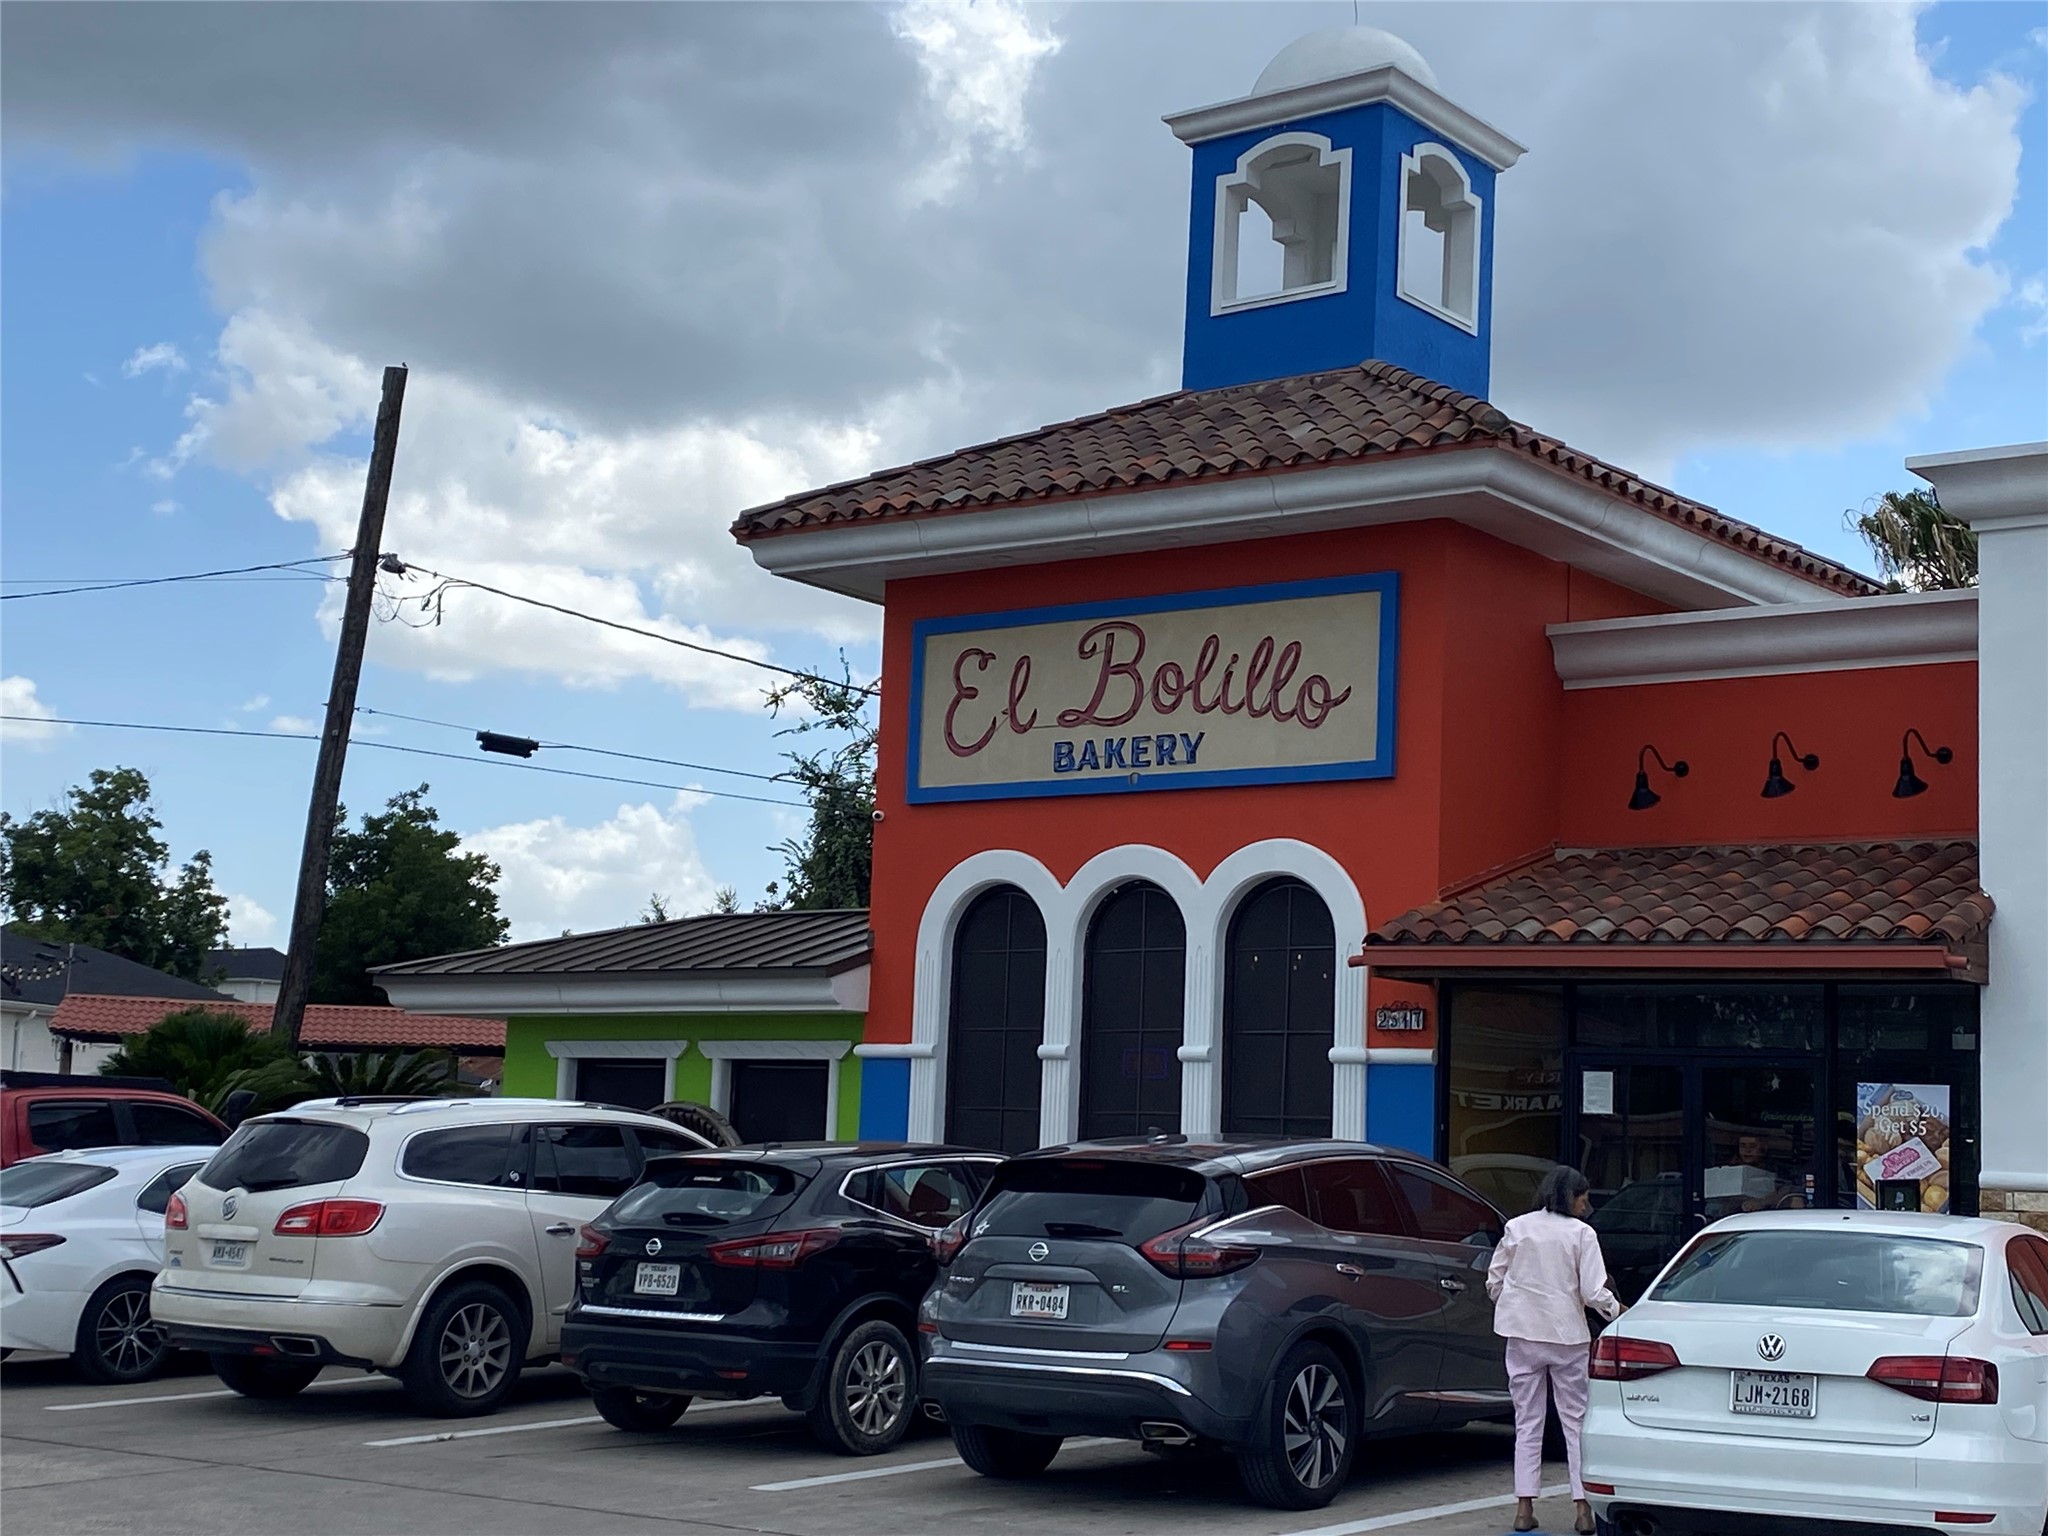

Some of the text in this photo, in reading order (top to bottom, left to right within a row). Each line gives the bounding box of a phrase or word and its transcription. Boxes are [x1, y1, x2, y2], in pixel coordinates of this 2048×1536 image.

[944, 621, 1351, 757] El Bolillo
[1053, 732, 1205, 772] BAKERY
[1377, 1009, 1422, 1029] 2517
[1863, 1101, 1944, 1120] Spend $20,
[1879, 1117, 1927, 1136] Get $5
[1112, 1285, 1129, 1293] SL
[1758, 1373, 1791, 1384] TEXAS
